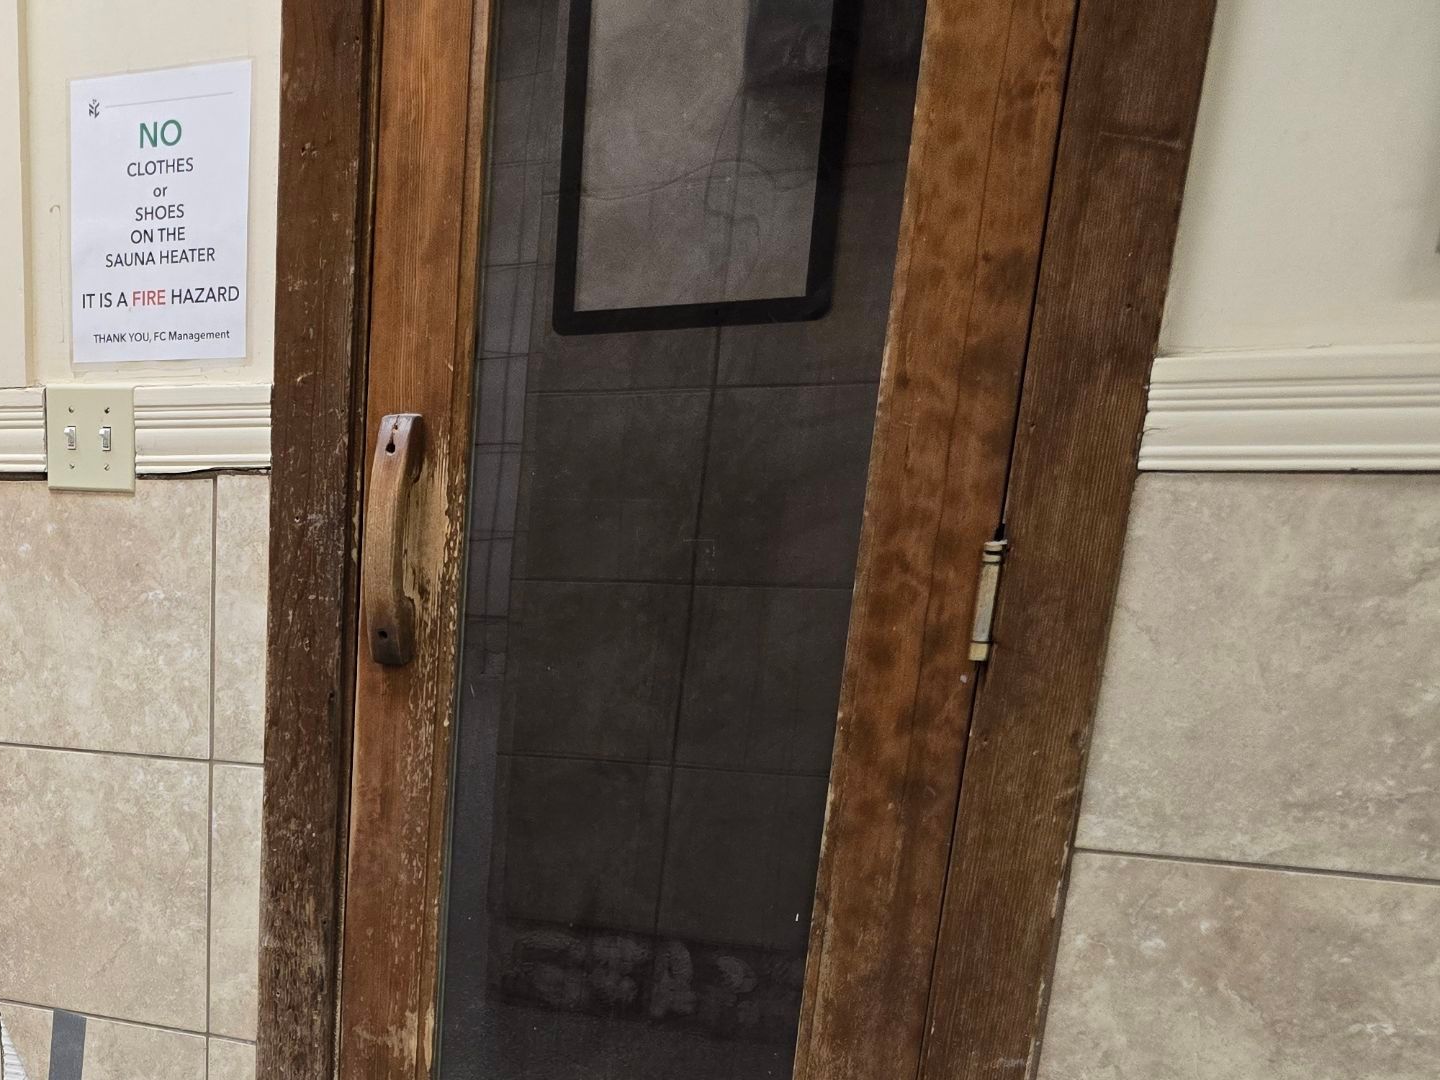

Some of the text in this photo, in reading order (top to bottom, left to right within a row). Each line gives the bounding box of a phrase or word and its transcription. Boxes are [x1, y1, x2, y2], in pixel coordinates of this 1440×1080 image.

[139, 119, 182, 149] NO
[127, 157, 194, 177] CLOTHES
[153, 185, 168, 198] or
[135, 204, 185, 222] SHOES
[130, 226, 186, 244] ON THE
[105, 247, 215, 268] SAUNA HEATER
[82, 285, 240, 309] IT IS A FIRE HAZARD
[93, 329, 230, 344] THANK YOU, FC Management
